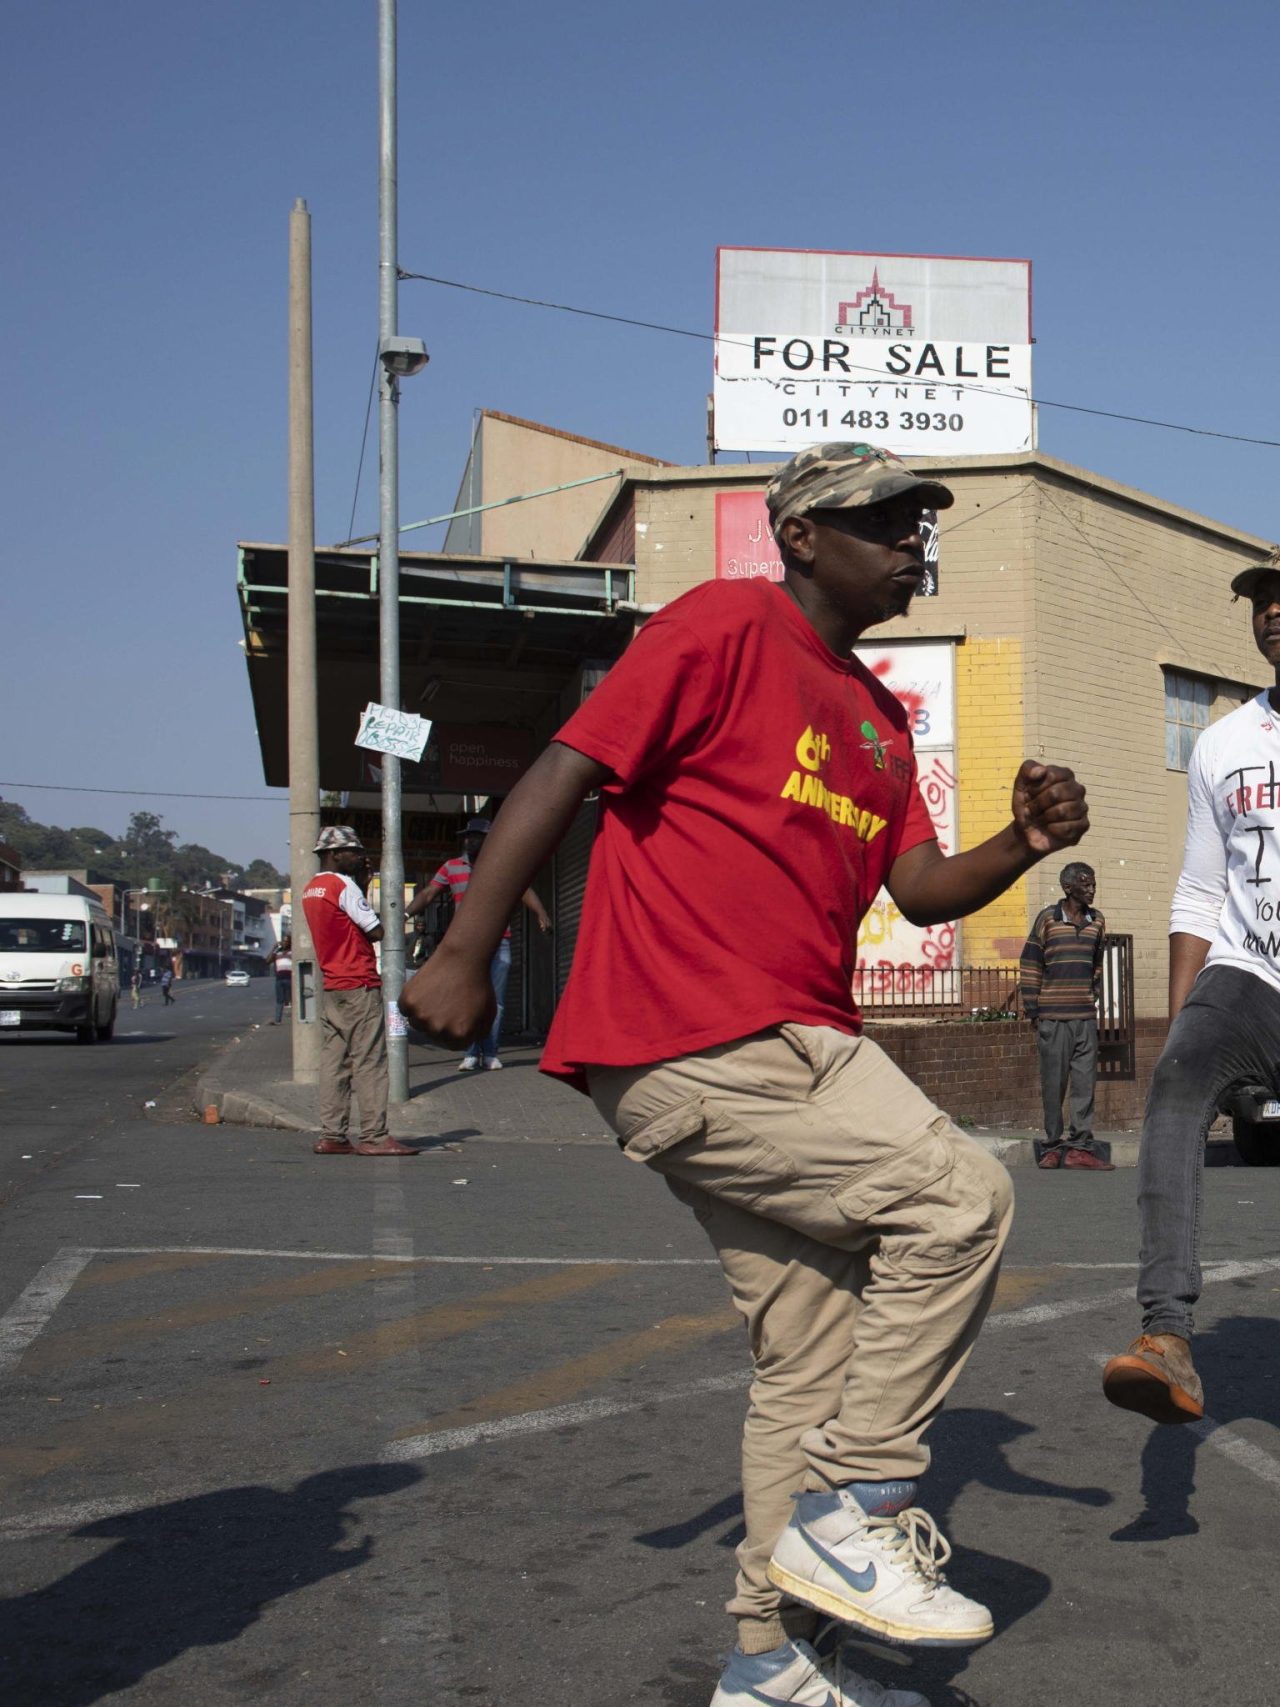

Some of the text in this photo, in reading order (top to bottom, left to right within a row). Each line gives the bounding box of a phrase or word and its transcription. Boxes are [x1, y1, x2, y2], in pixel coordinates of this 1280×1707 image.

[834, 325, 915, 337] CITYNET
[753, 336, 1011, 379] FOR SALE
[782, 383, 964, 402] CITYNET
[782, 408, 964, 432] 011 483 3930
[449, 742, 486, 755] open
[449, 754, 520, 769] happiness
[71, 963, 83, 977] G
